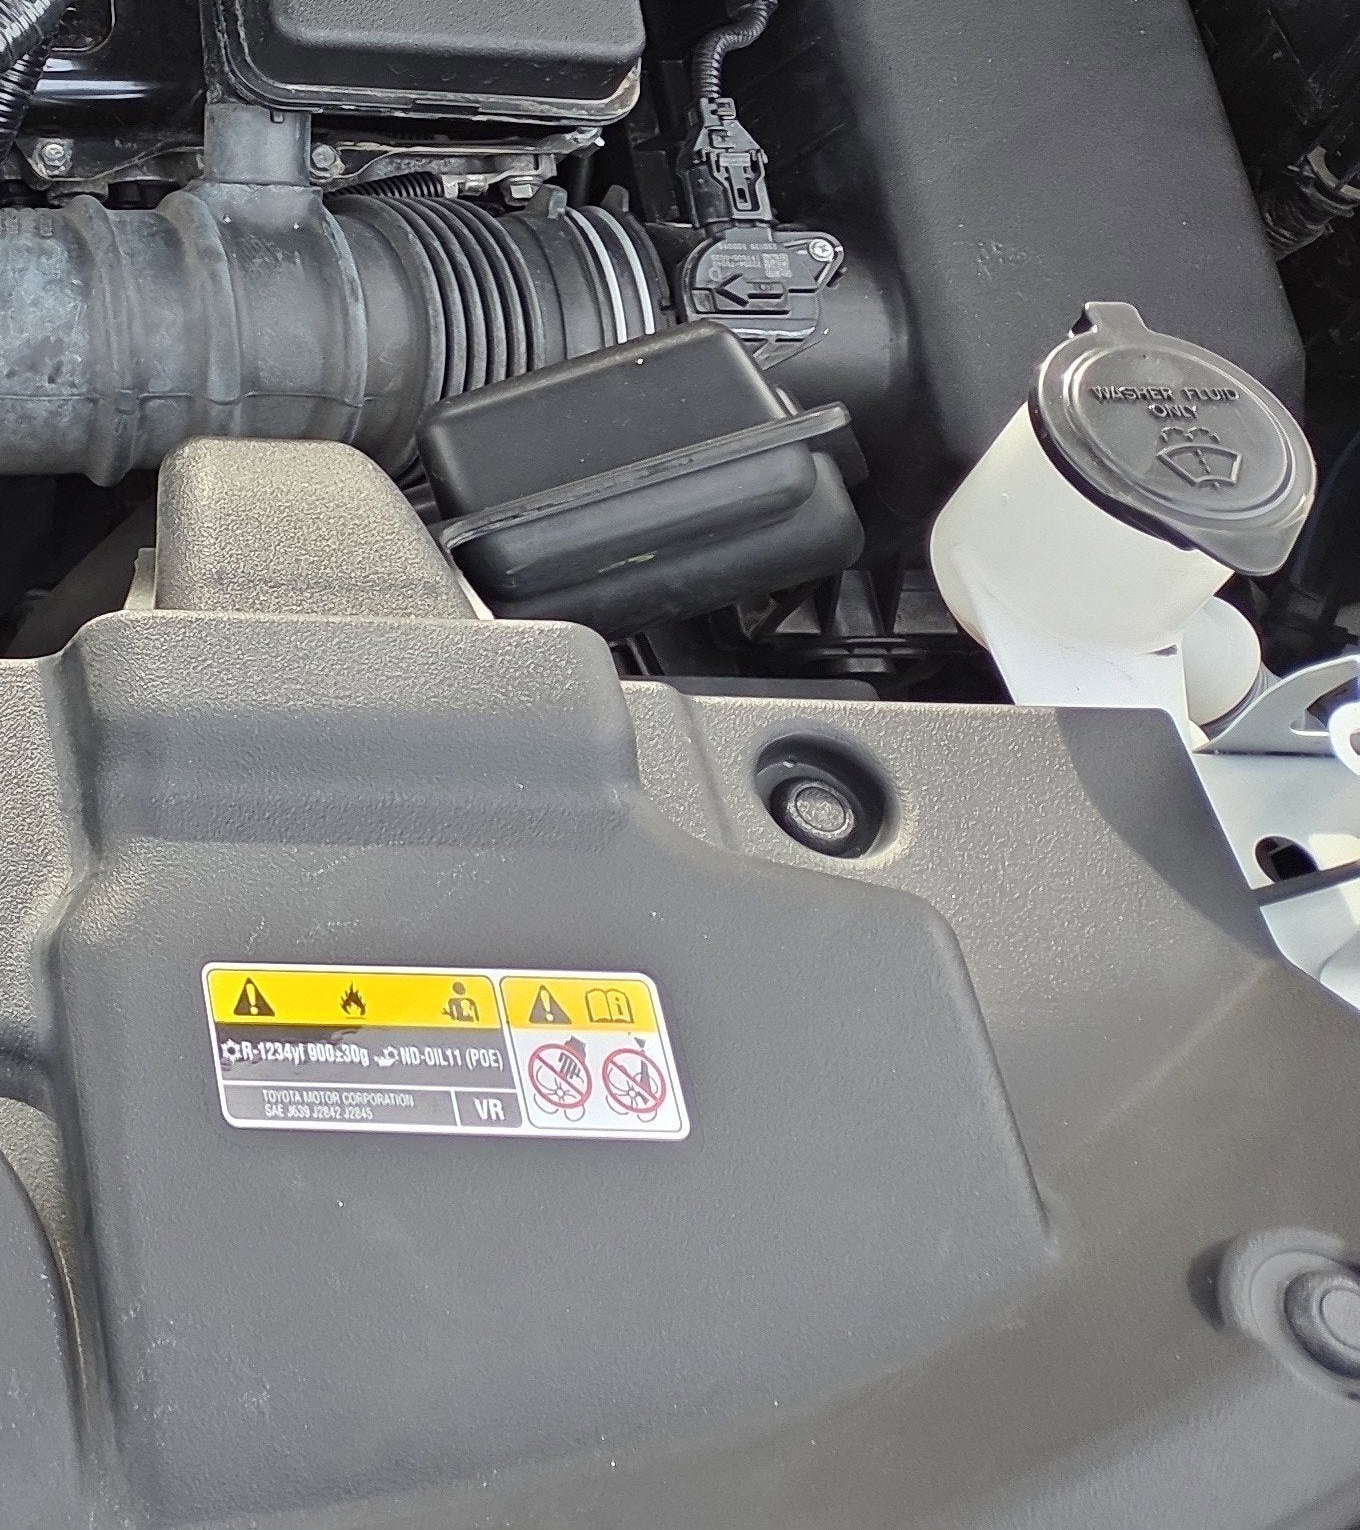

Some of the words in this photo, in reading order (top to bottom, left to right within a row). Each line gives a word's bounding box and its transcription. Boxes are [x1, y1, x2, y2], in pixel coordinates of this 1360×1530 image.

[1090, 385, 1175, 403] WASHER
[1182, 386, 1240, 402] FLUID
[1148, 403, 1198, 420] ONLY
[241, 1041, 307, 1066] R-1234yf
[400, 1046, 462, 1067] ND-OIL11
[466, 1047, 505, 1072] (POE)
[262, 1089, 302, 1103] TOYOTA
[303, 1091, 340, 1104] MOTOR
[342, 1092, 415, 1107] CORPORATION
[264, 1104, 285, 1117] SAE
[312, 1105, 342, 1119] J2842
[474, 1098, 506, 1121] VR
